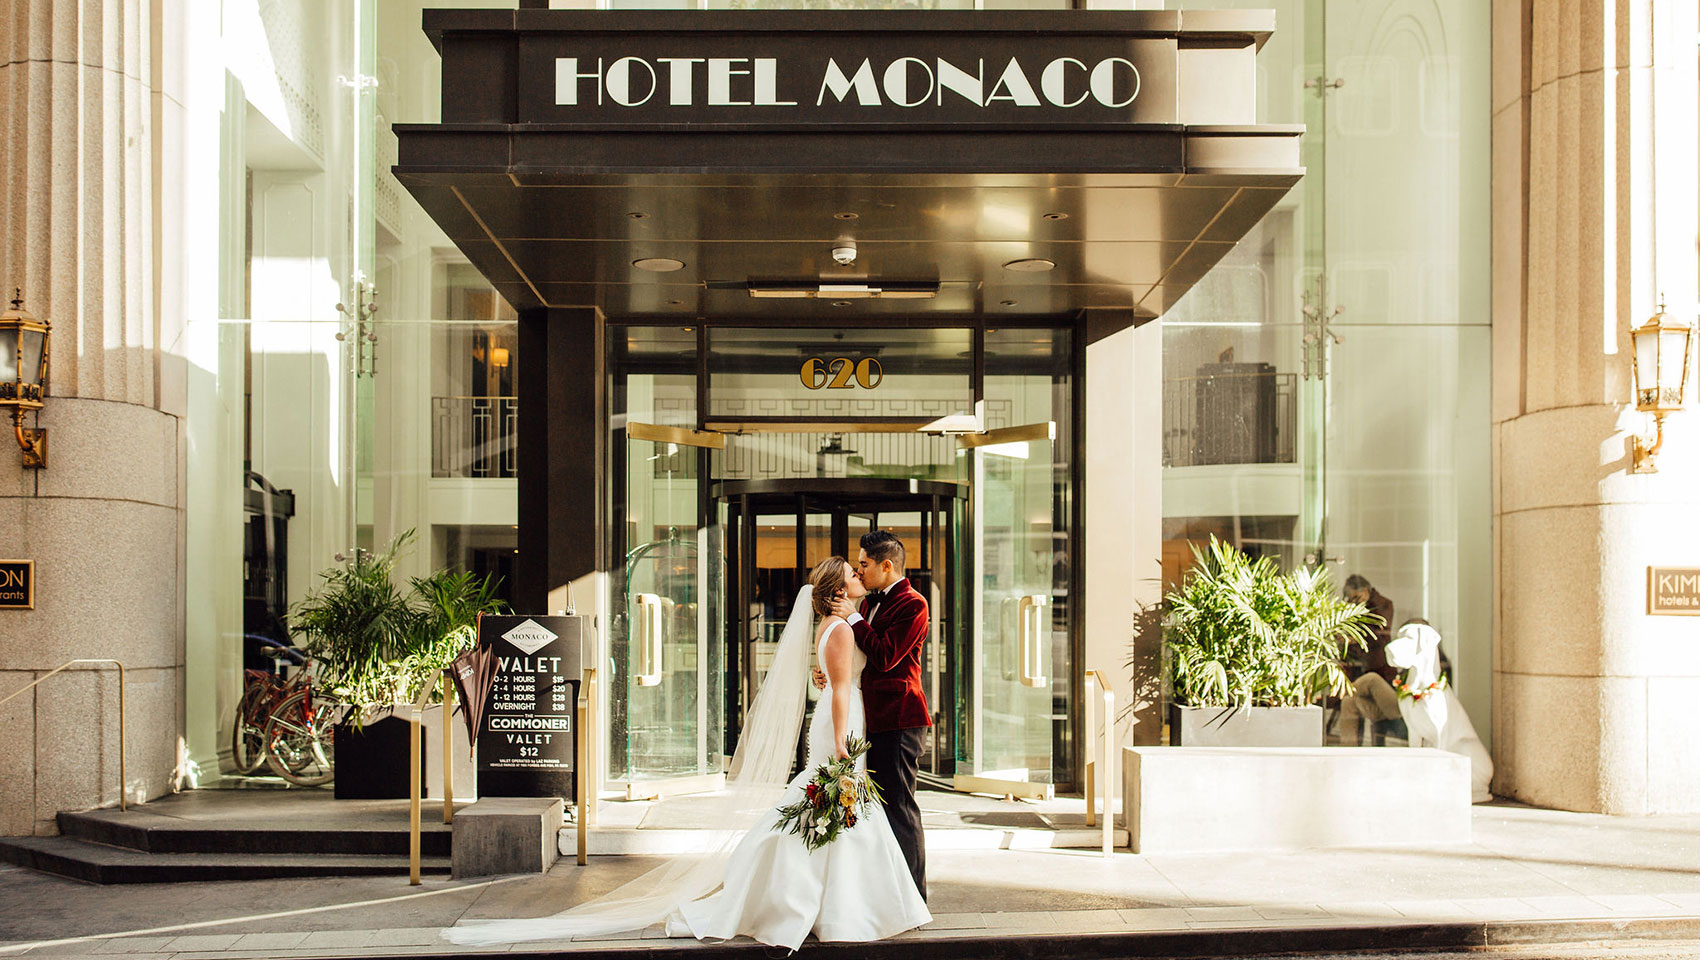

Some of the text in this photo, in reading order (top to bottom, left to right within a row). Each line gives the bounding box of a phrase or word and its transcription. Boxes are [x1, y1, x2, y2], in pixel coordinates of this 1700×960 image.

[555, 57, 1141, 107] HOTEL MONACO
[800, 357, 883, 389] 620
[1659, 574, 1700, 594] KIM
[1659, 596, 1699, 606] hotels &
[498, 657, 561, 673] VALET
[513, 675, 536, 683] HOURS
[552, 675, 565, 684] $15
[552, 684, 566, 693] $20
[493, 702, 536, 710] OVERNIGHT
[491, 718, 568, 729] COMMONER
[506, 734, 552, 744] VALET
[520, 746, 539, 757] $12
